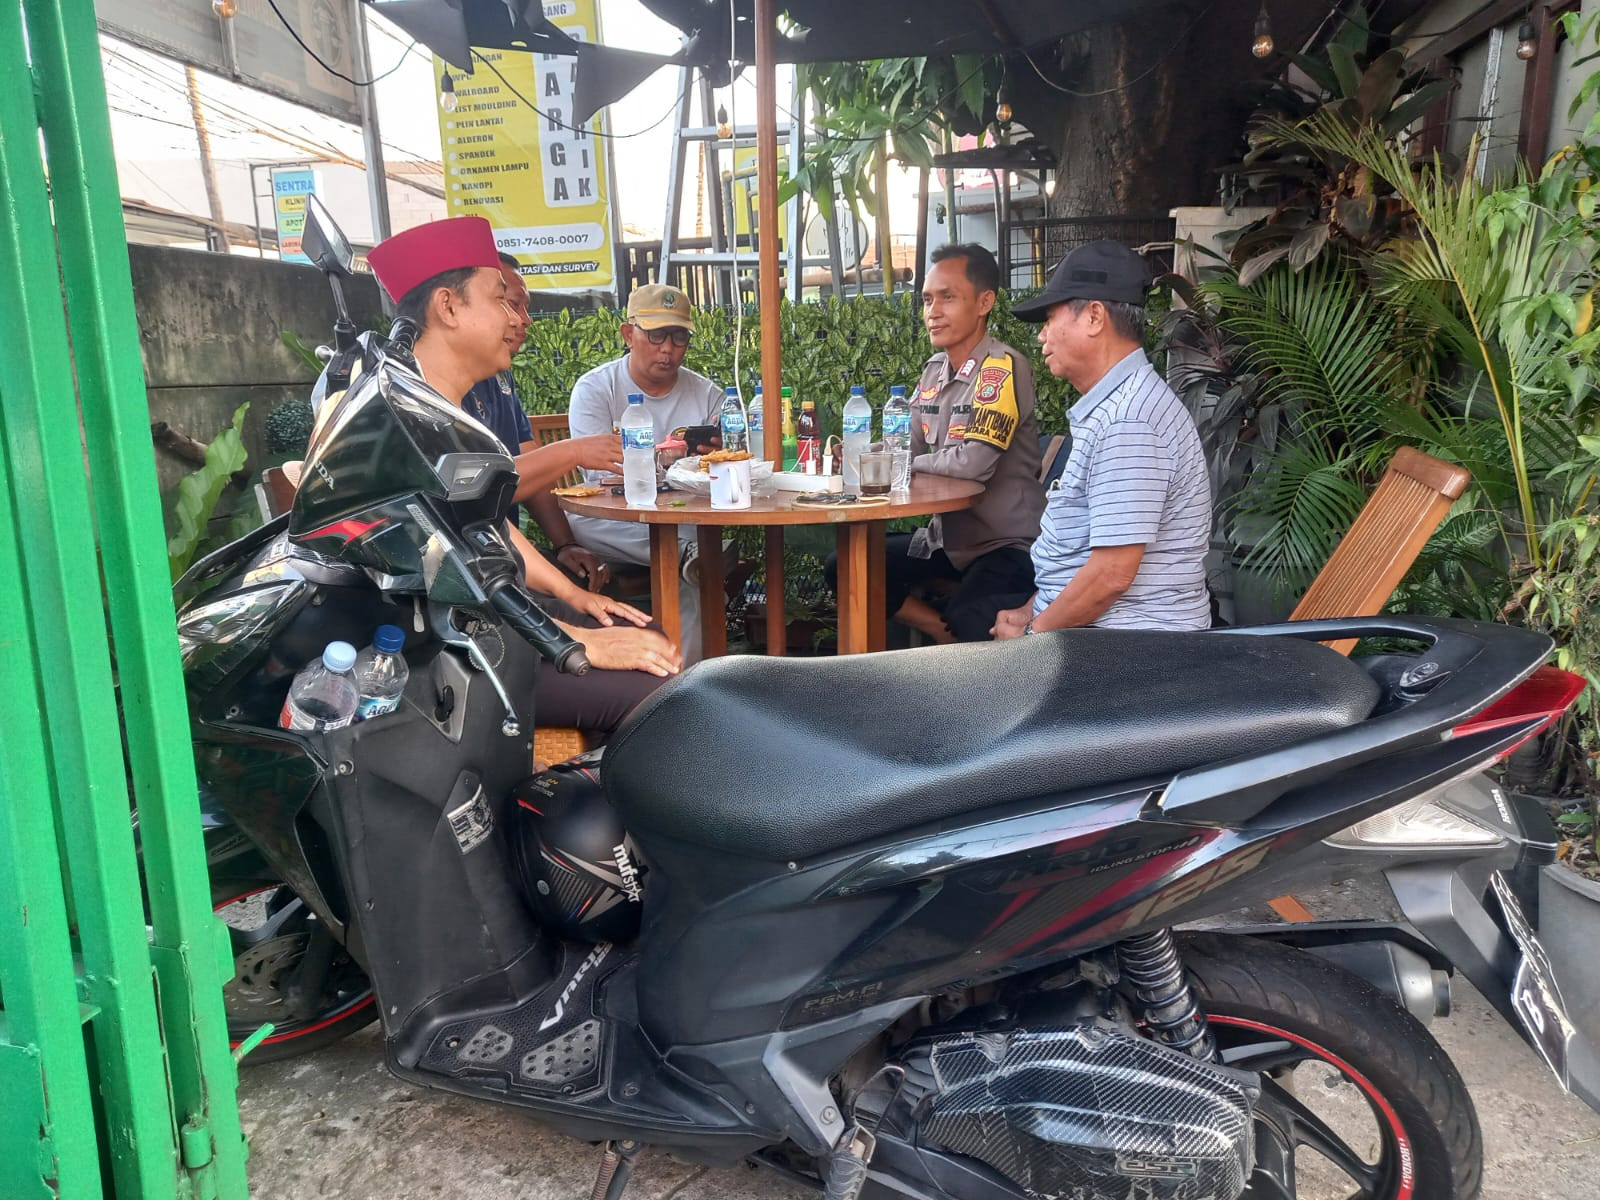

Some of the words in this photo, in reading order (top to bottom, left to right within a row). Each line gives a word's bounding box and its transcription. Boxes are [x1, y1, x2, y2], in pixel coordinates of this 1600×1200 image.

[455, 104, 472, 113] LIST
[474, 100, 517, 111] MOULDING
[476, 117, 504, 127] LANTAI
[458, 134, 493, 144] ALDERON
[459, 150, 496, 160] SPANDEK
[460, 165, 500, 175] ORNAMEN
[502, 162, 529, 172] LAMPU
[275, 179, 314, 192] SENTRA
[461, 181, 493, 191] KANOPI
[464, 196, 504, 206] RENOVASI
[497, 234, 589, 248] 0851-7408-0007
[519, 264, 541, 274] LTASI
[542, 263, 561, 273] DAN
[563, 261, 598, 272] SURVEY
